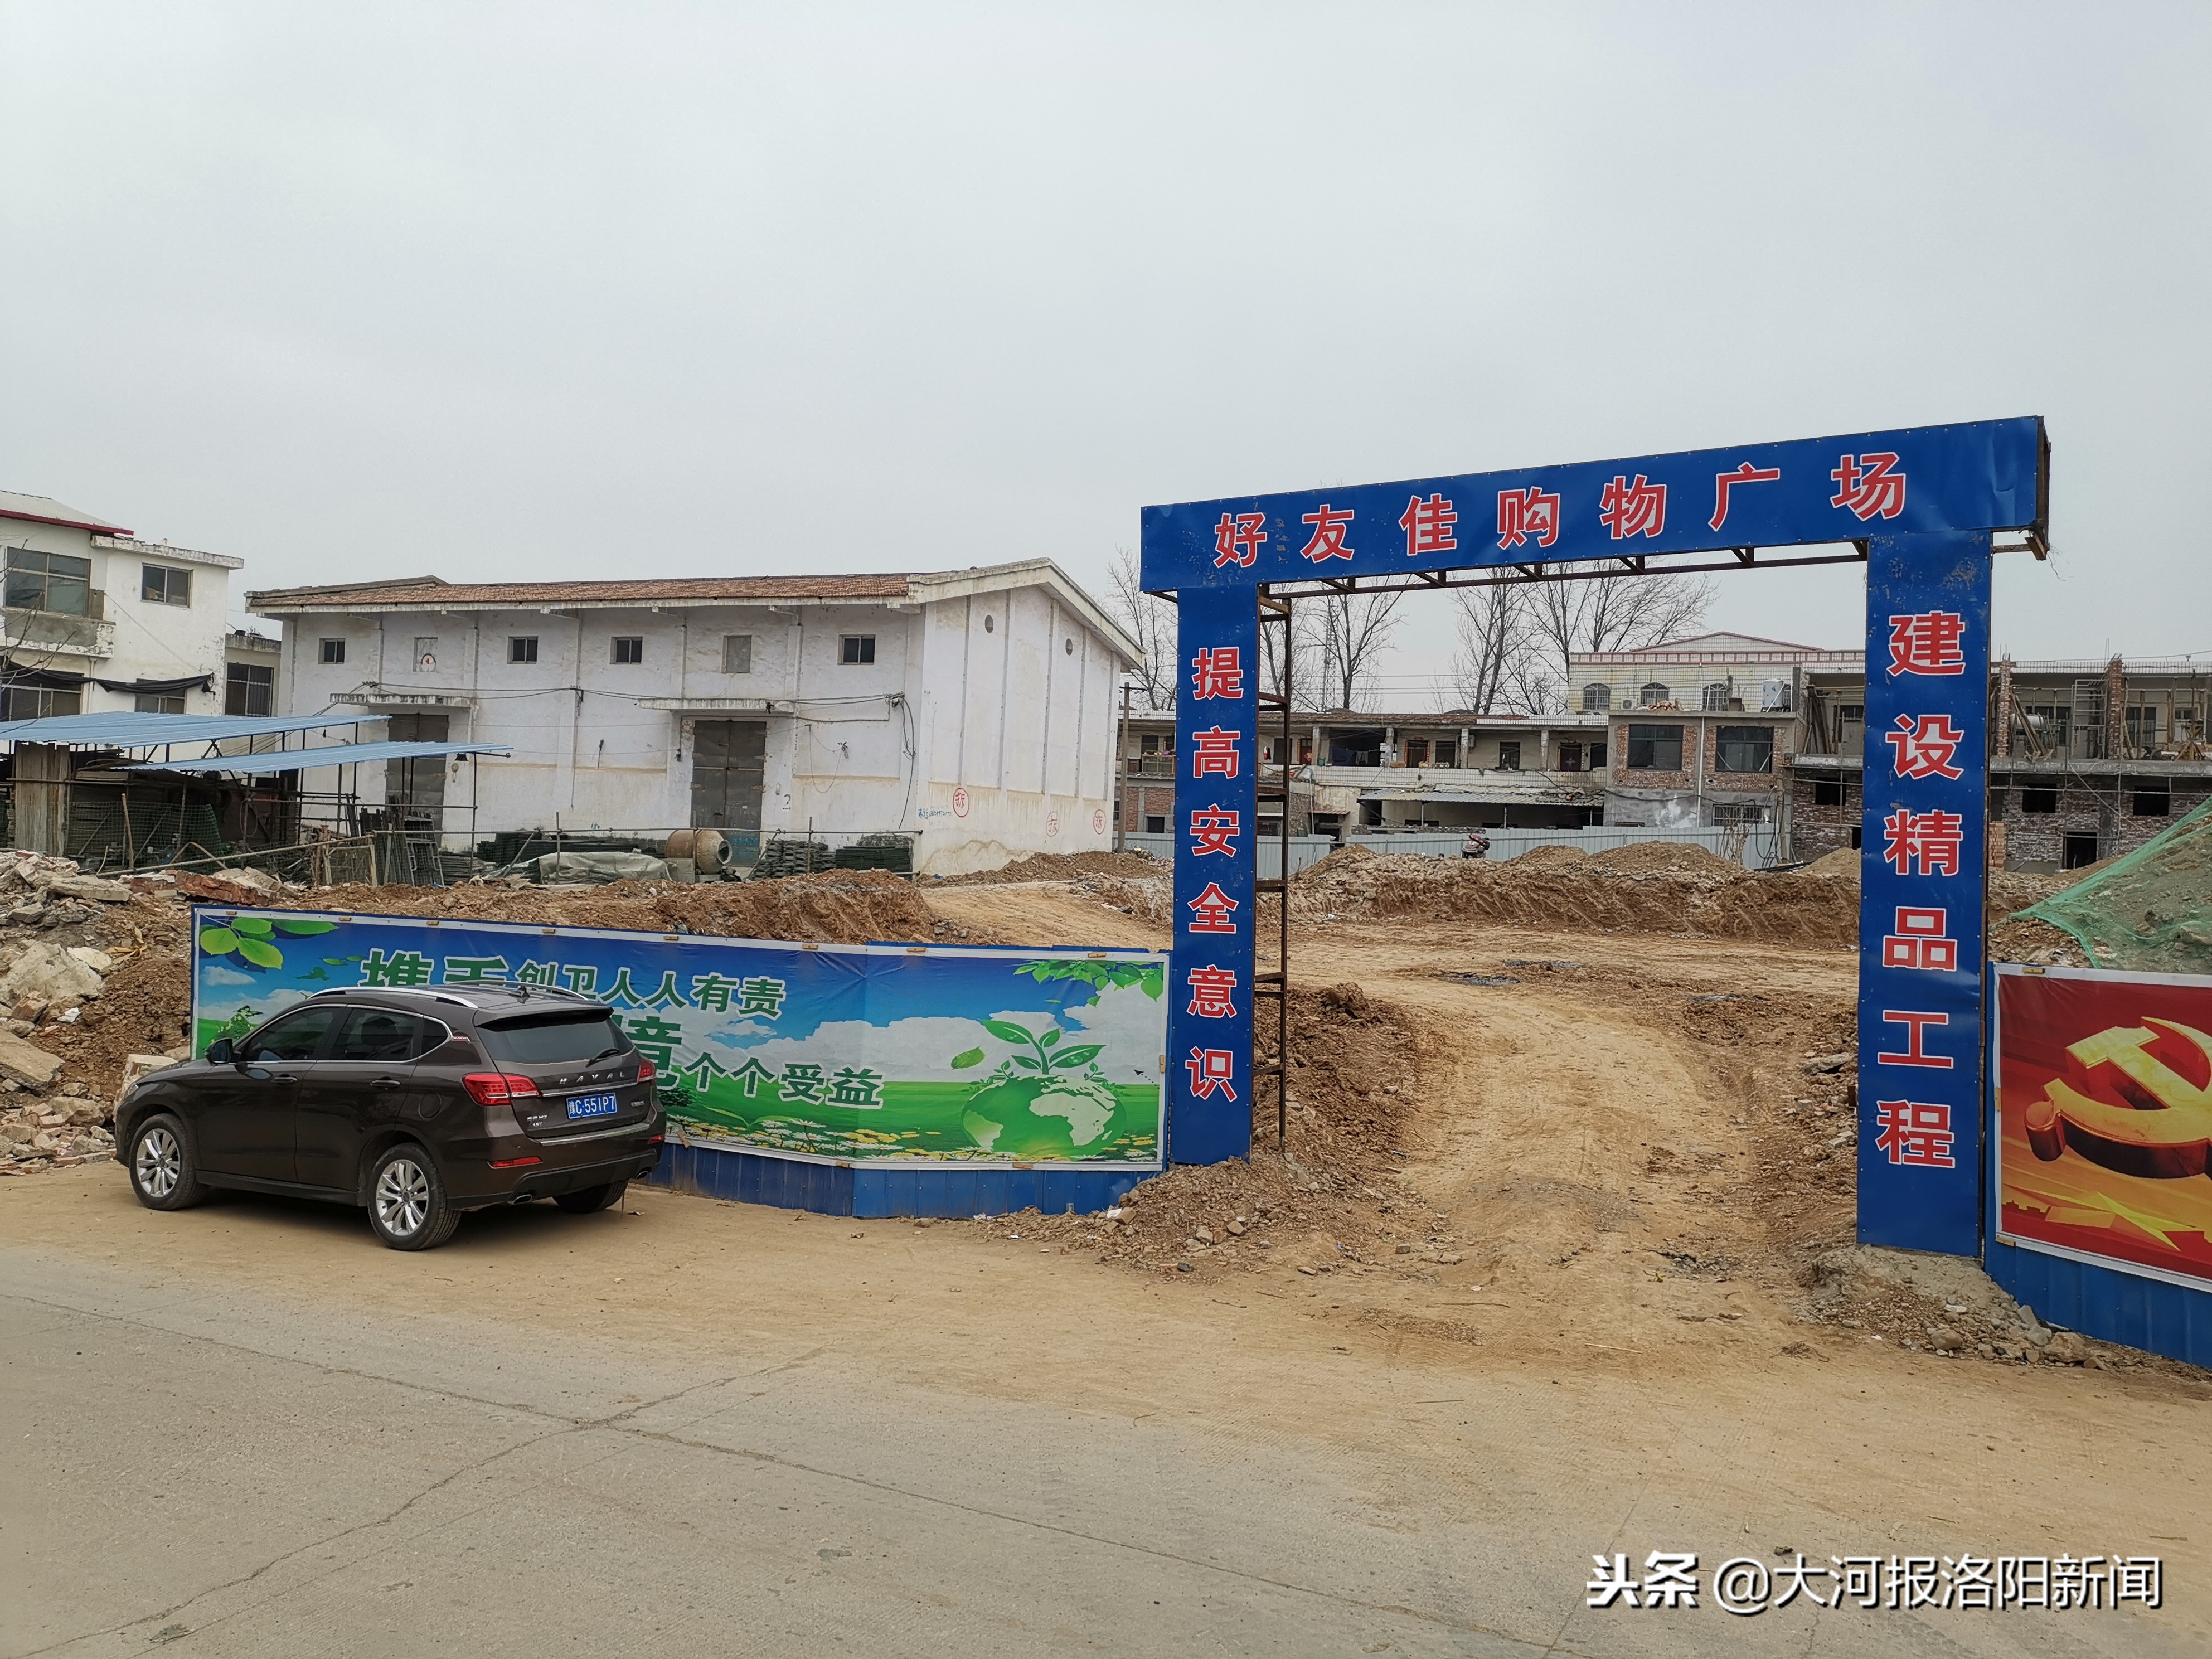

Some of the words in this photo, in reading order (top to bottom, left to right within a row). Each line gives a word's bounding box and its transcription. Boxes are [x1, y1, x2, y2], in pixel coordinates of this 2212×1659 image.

[1214, 451, 1907, 569] 好友佳购物广场
[1185, 646, 1244, 1102] 提高安全意识
[1876, 610, 1966, 1169] 建设精品工程
[559, 1071, 625, 1085] HAVAL
